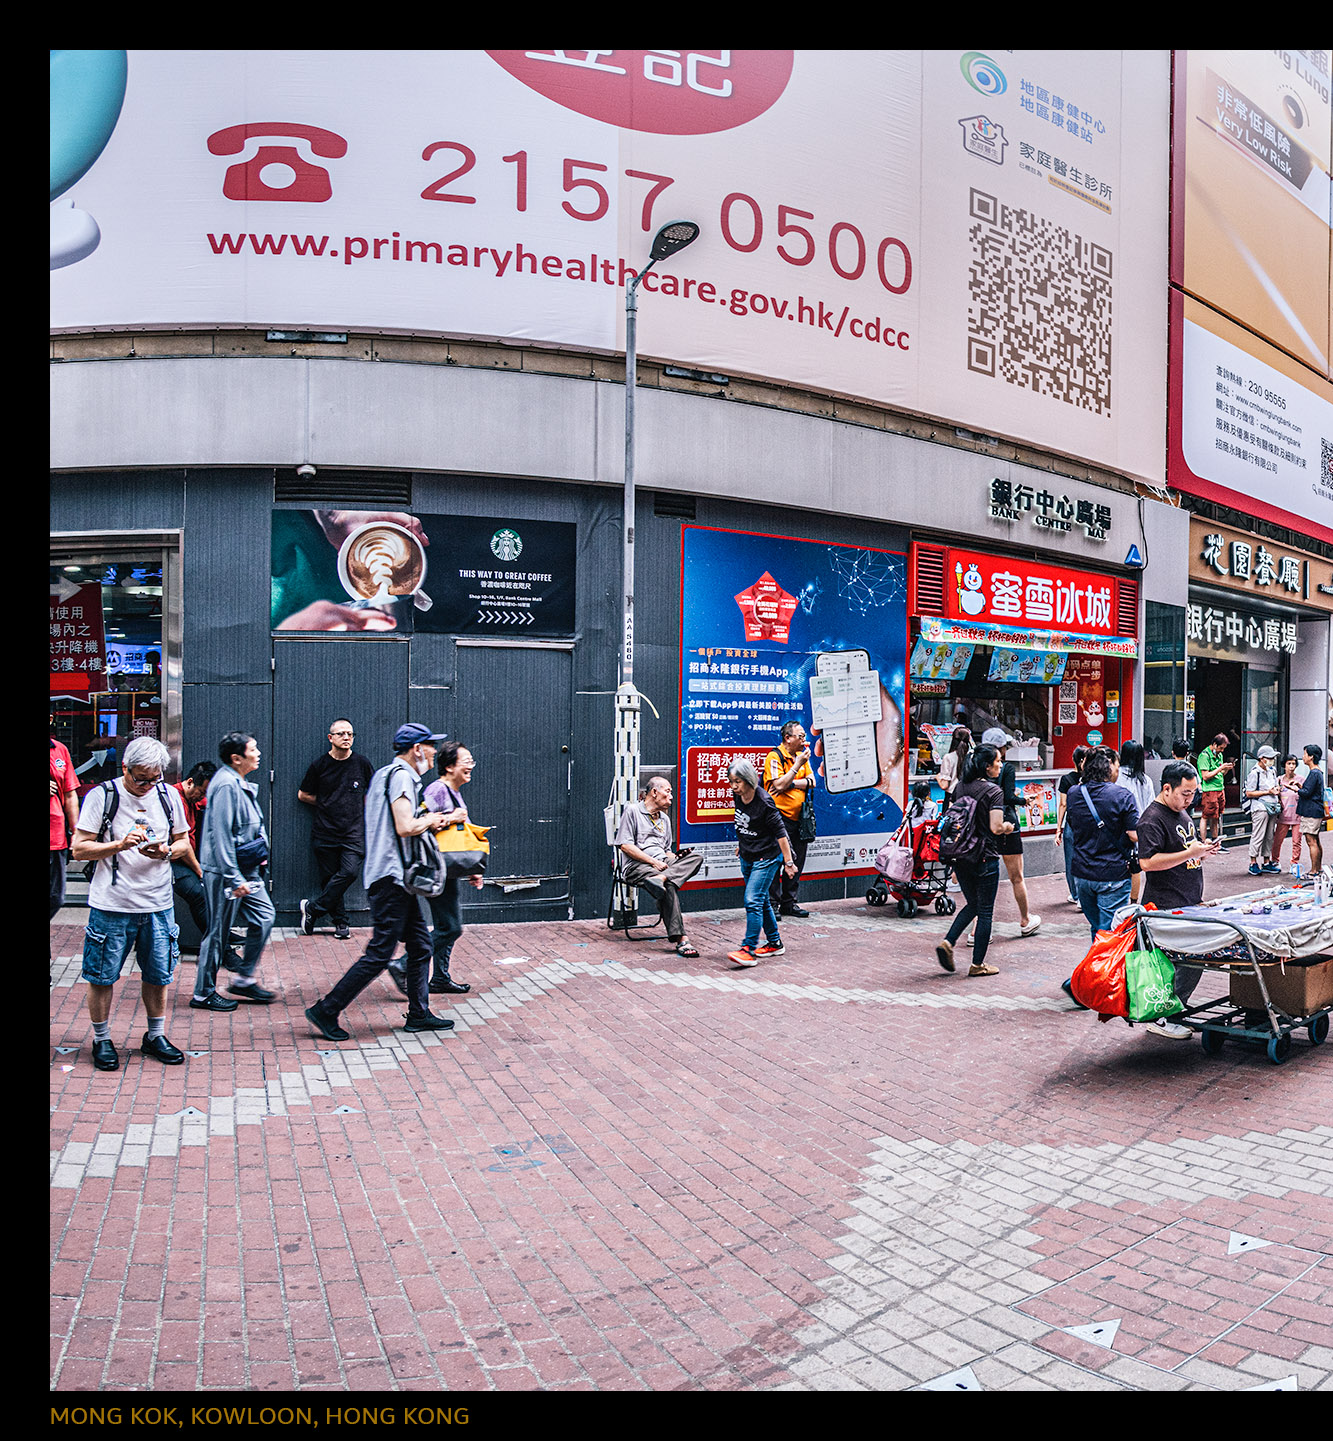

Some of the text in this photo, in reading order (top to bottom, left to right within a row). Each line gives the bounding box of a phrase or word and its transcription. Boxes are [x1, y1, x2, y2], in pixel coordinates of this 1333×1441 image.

[1020, 78, 1106, 134] 地區康健中心
[1296, 59, 1329, 104] Lung
[1020, 95, 1093, 144] 地區康健站
[1216, 108, 1292, 178] Very Low Risk
[1217, 86, 1291, 158] 非常低風險
[1020, 141, 1113, 201] 家庭醫生診所
[420, 140, 914, 295] 2157 0500
[206, 231, 911, 351] www.primaryhealthcare.gov.hk/cdcc
[1248, 380, 1262, 397] 230
[1264, 389, 1287, 410] 95555
[990, 477, 1112, 531] 銀行中心廣場
[991, 505, 1021, 521] BANK
[1035, 515, 1073, 533] CENTRE
[459, 569, 552, 582] THIS WAY TO GREAT COFFEE
[1201, 533, 1302, 594] 花園餐廳
[989, 570, 1112, 629] 蜜雪冰城
[1186, 603, 1297, 655] 銀行中心廣場
[689, 661, 789, 678] 招商永隆銀行手機App
